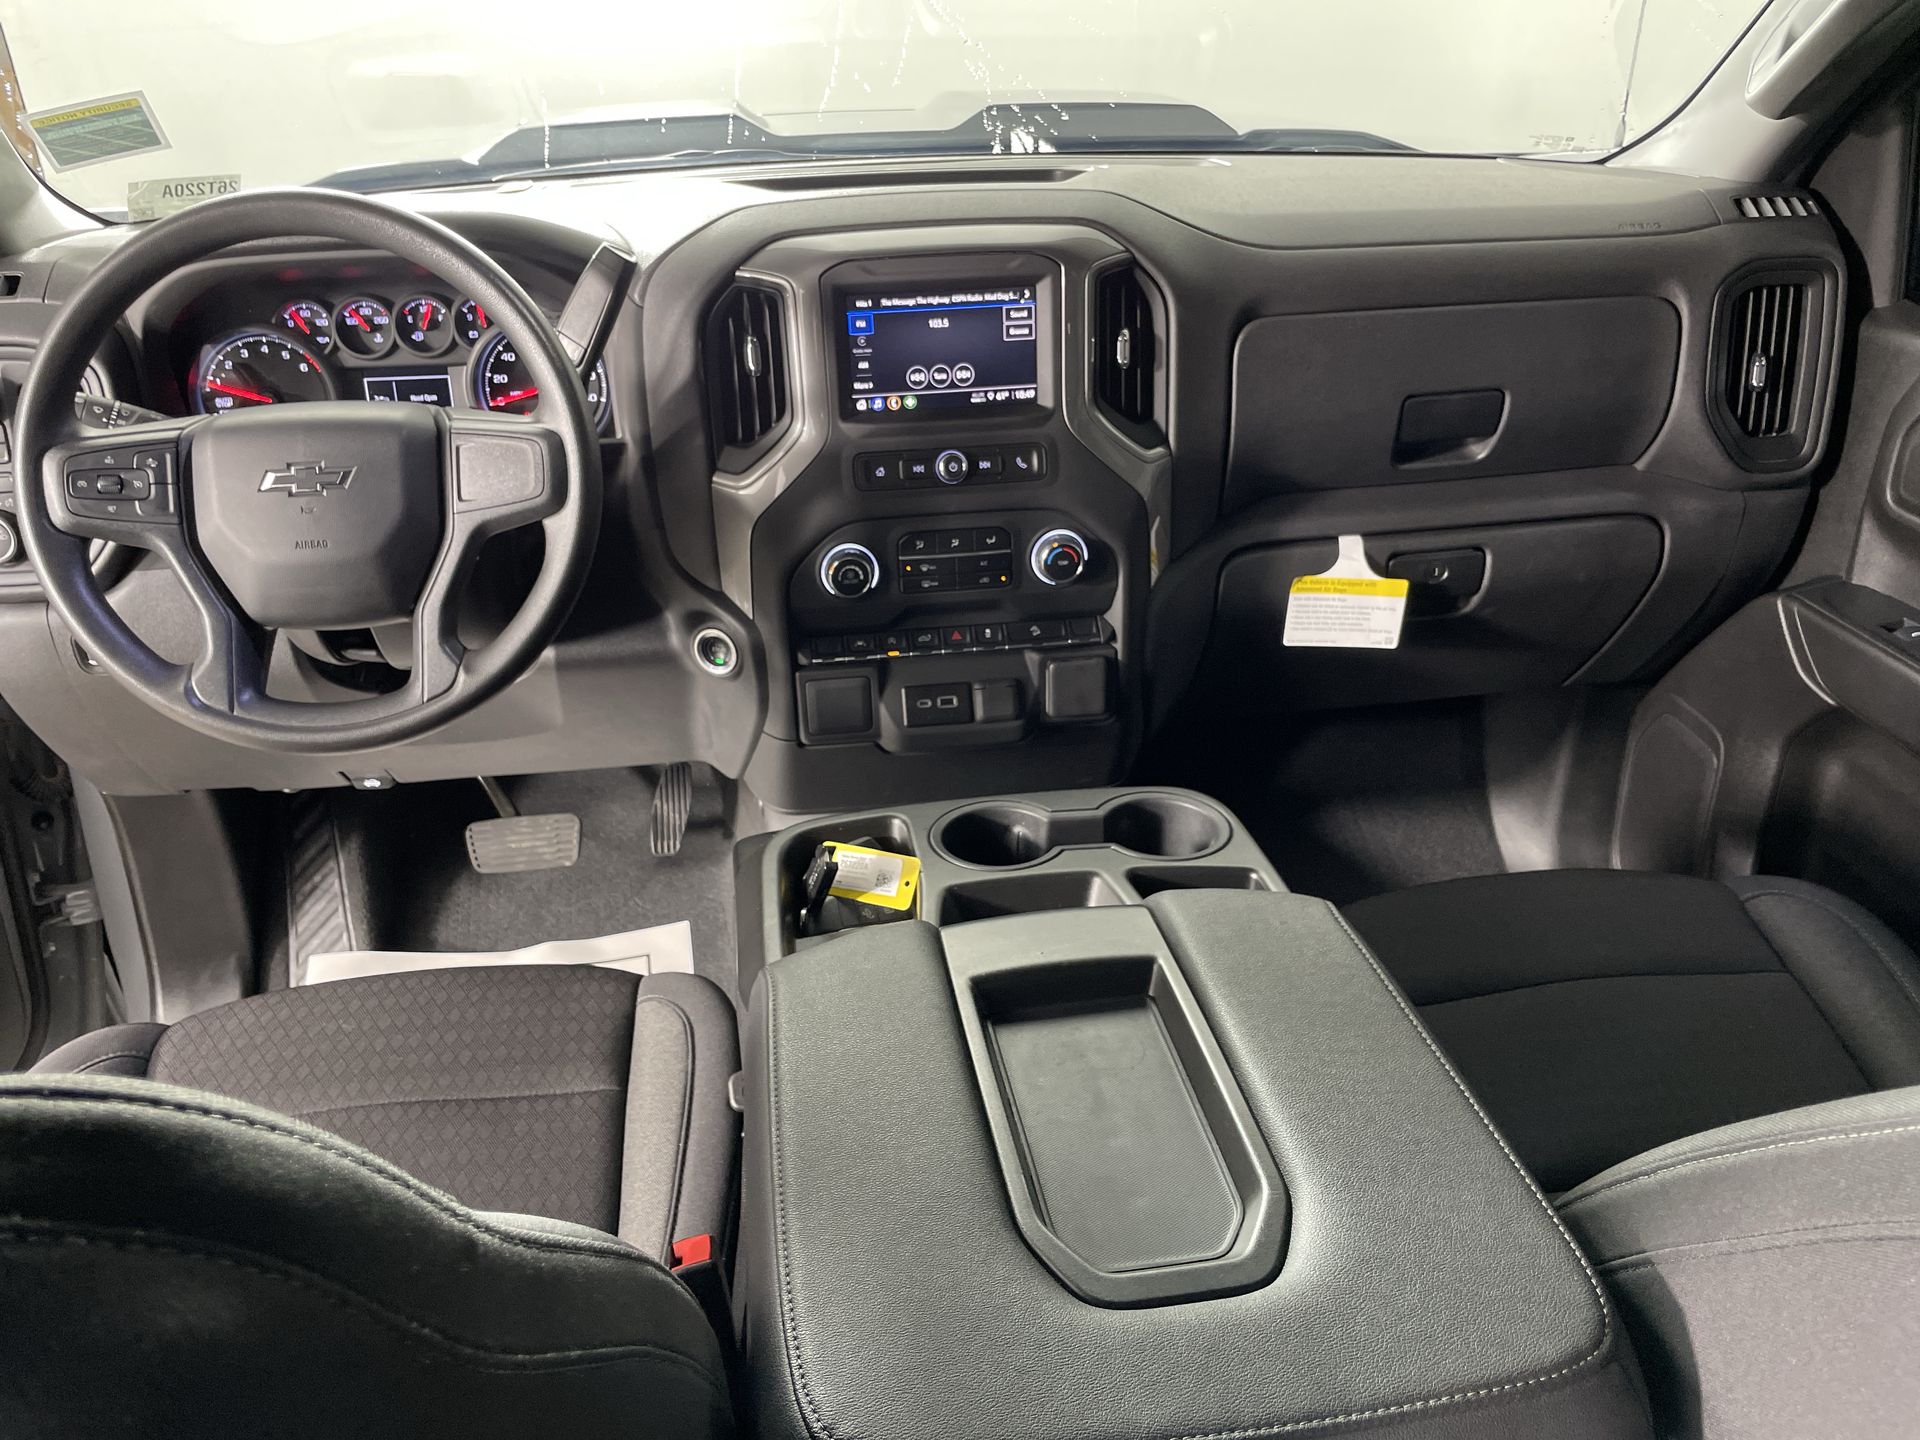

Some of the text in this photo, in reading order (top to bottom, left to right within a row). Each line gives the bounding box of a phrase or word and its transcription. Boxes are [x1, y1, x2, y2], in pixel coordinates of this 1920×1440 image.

[500, 351, 516, 362] 40
[492, 373, 508, 384] 20
[294, 540, 329, 550] AIRBAG
